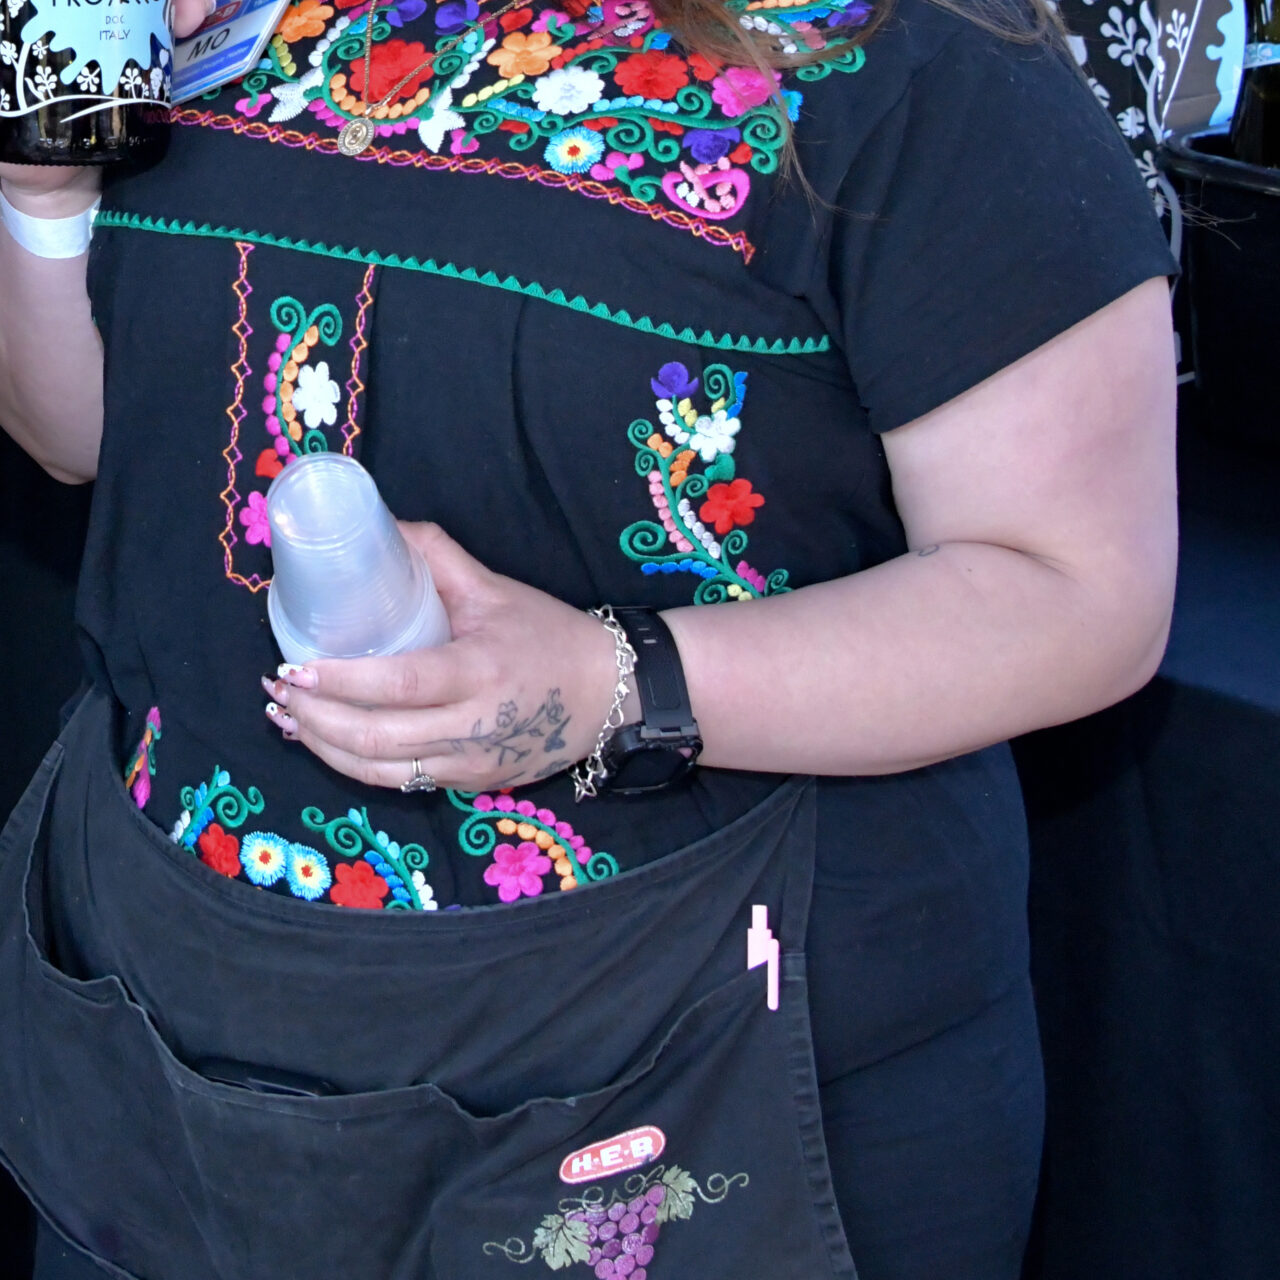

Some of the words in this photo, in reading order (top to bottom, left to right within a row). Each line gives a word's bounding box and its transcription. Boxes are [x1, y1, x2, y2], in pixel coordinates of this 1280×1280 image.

[105, 16, 125, 25] DOC
[99, 28, 131, 40] ITALY
[186, 27, 231, 63] MO
[571, 1135, 655, 1175] H-E-B
